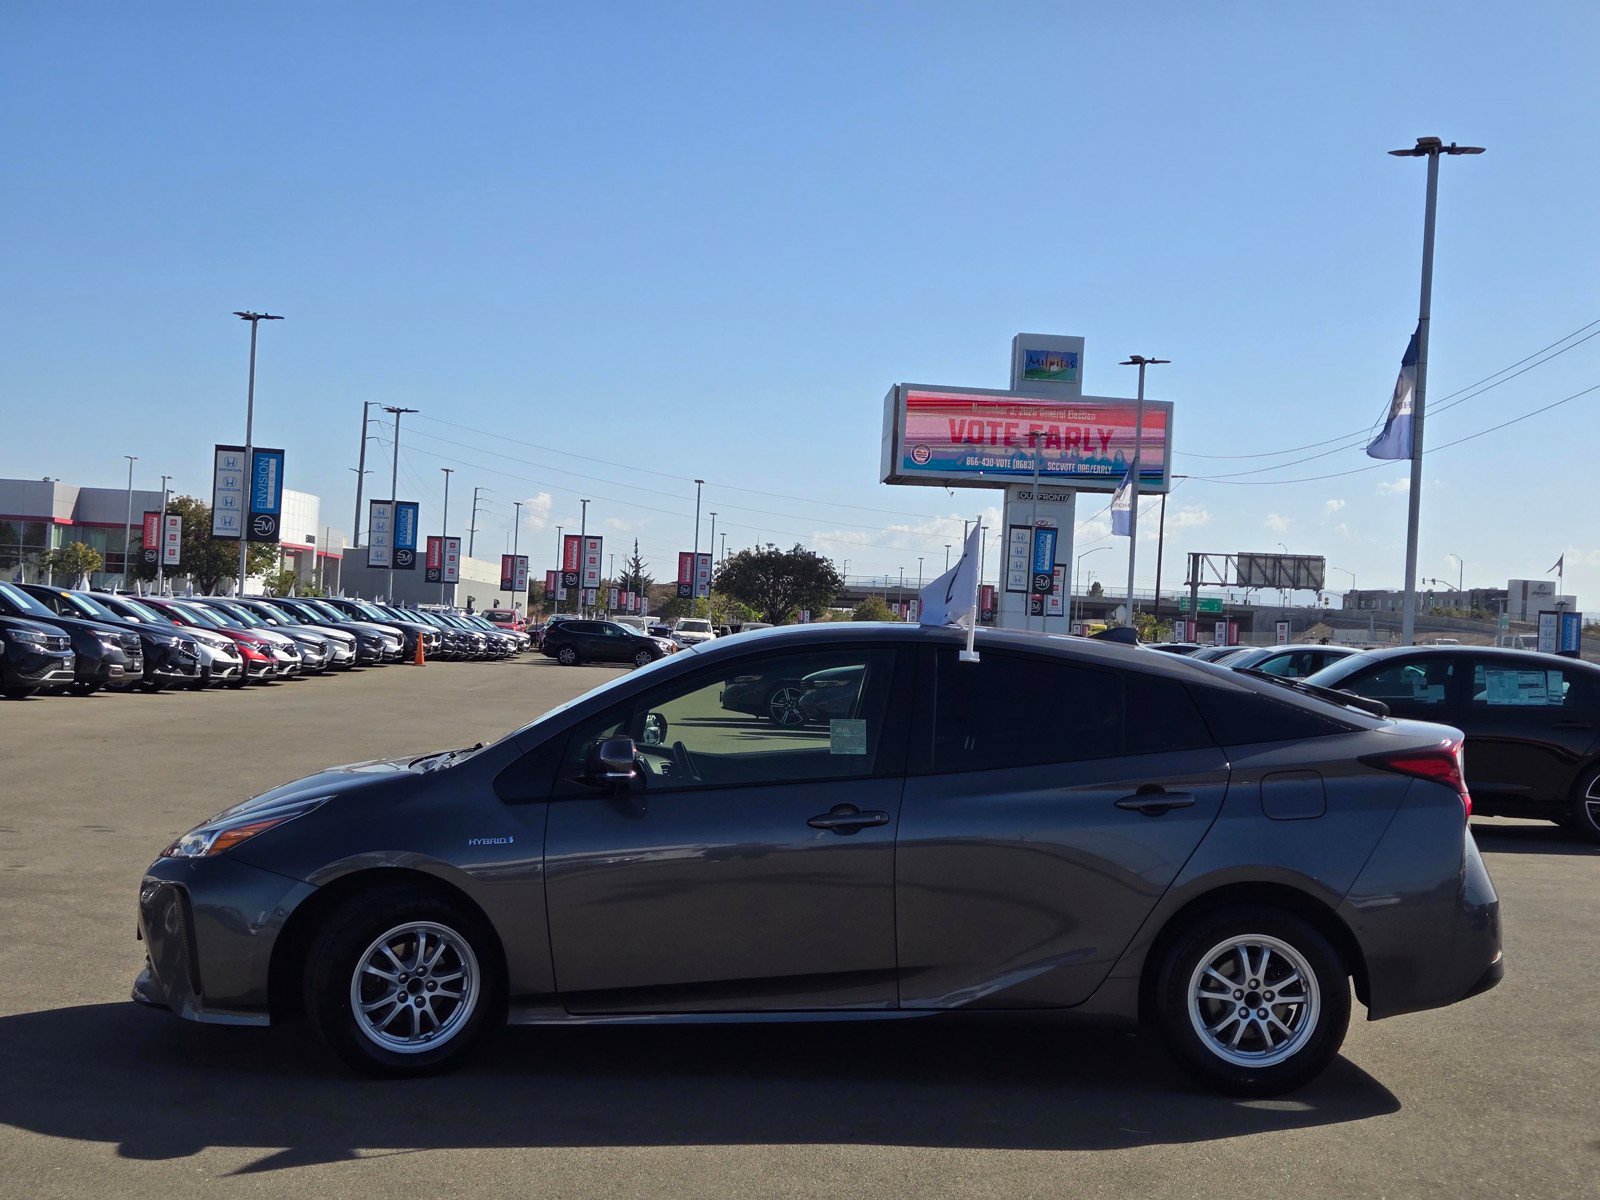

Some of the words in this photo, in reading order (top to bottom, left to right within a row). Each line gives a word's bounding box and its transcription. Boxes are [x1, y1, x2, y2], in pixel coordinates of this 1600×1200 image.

[1028, 351, 1075, 372] Milpitas
[1068, 410, 1096, 421] Election
[948, 418, 1019, 447] VOTE
[1028, 423, 1114, 453] EARLY
[257, 457, 269, 509] ENVISION
[398, 507, 408, 545] ENVISION
[1037, 533, 1047, 571] ENVISION
